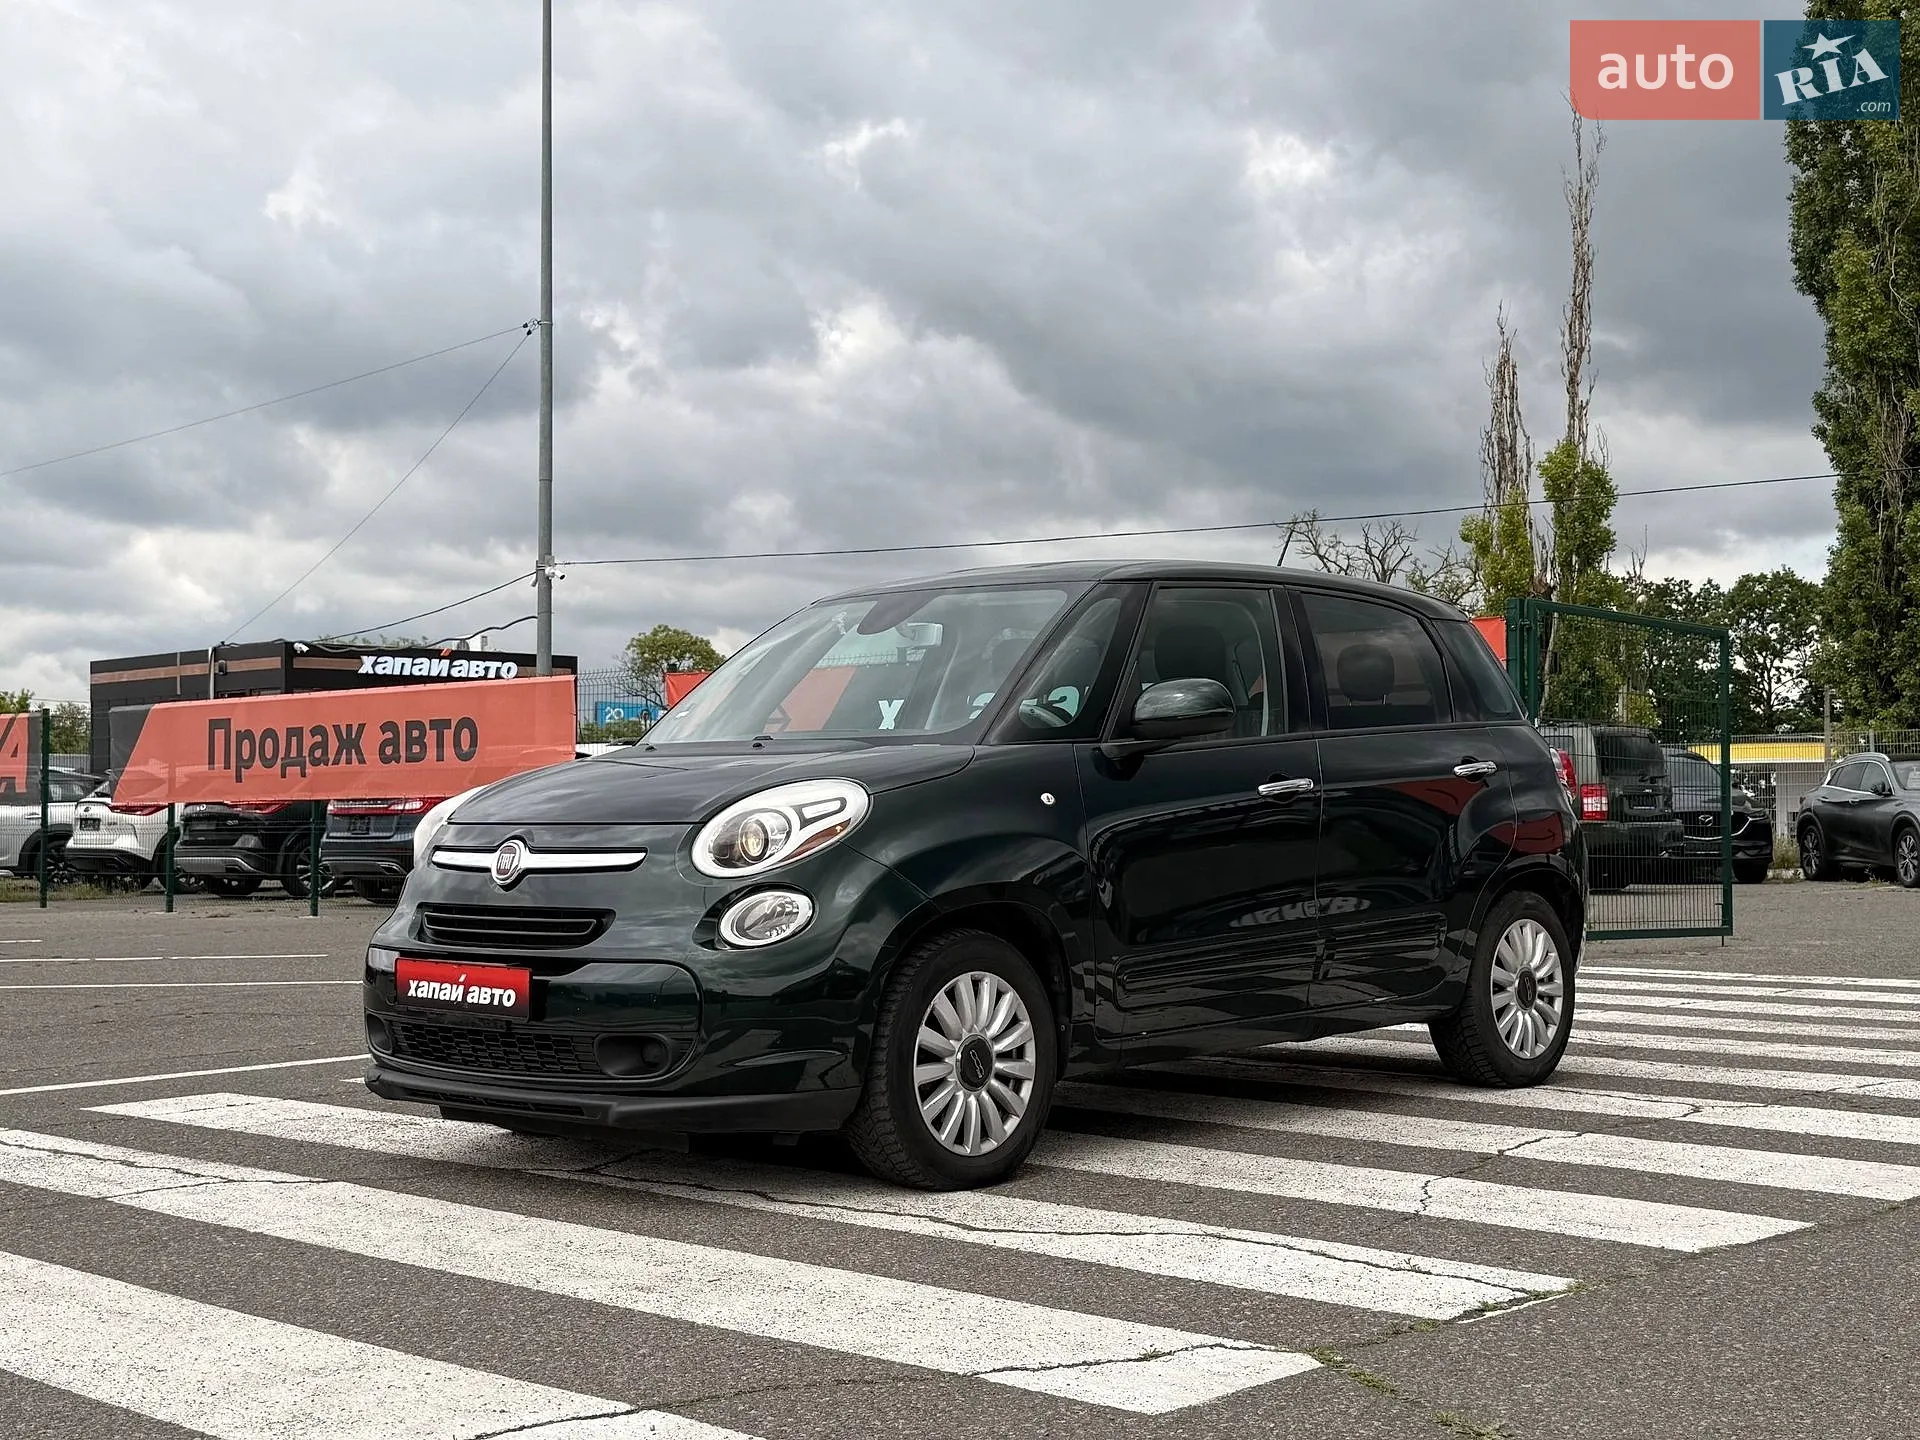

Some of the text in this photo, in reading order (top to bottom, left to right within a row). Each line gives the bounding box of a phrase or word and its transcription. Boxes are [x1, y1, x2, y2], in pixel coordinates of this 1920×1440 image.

[207, 716, 479, 783] Продаж авто
[466, 985, 516, 1008] авто
